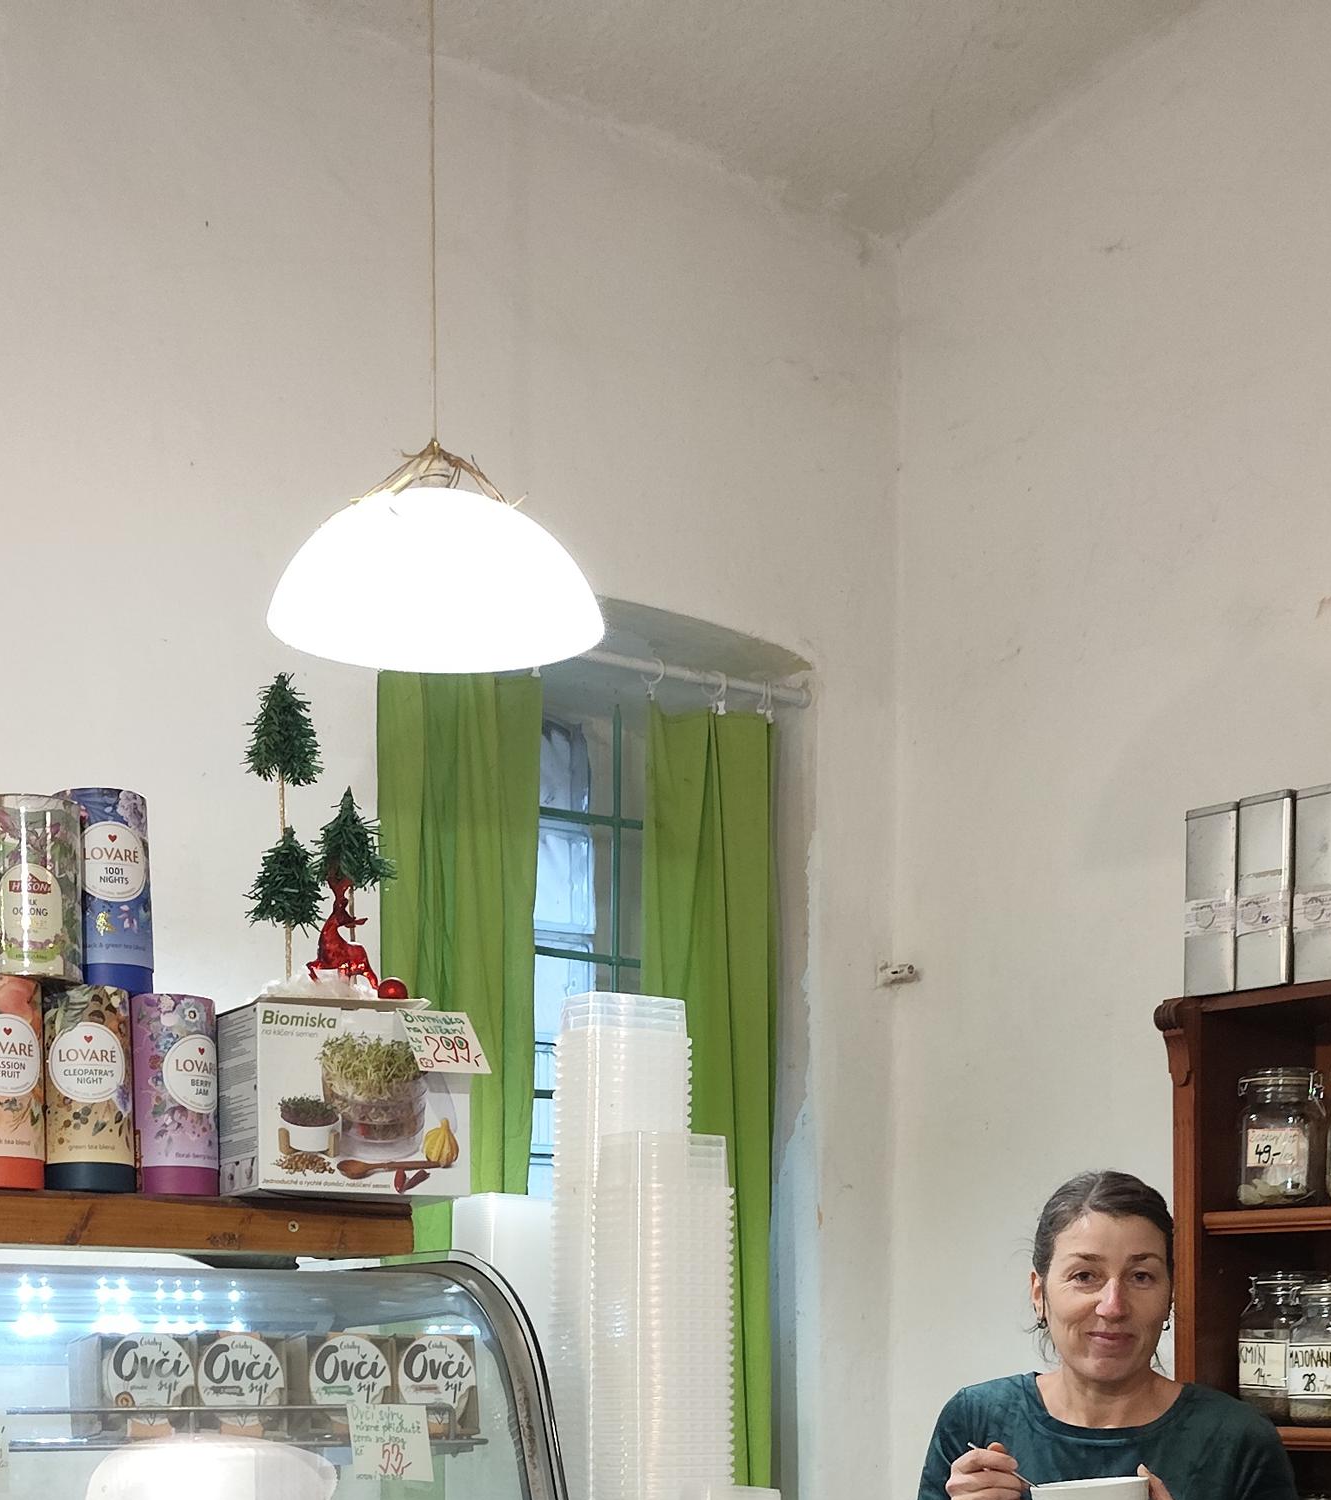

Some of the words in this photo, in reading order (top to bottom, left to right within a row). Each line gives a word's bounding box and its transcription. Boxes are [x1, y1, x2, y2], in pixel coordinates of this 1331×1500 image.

[82, 846, 139, 864] LOVARÉ
[104, 867, 124, 875] 1001
[99, 875, 129, 885] NIGHTS
[261, 1009, 337, 1030] Biomiska
[58, 1047, 117, 1064] LOVARÉ
[63, 1066, 115, 1078] CLEOPATRA'S
[76, 1076, 103, 1086] NIGHT
[190, 1078, 211, 1088] BERRY
[113, 1340, 191, 1382] Ovčí
[204, 1343, 279, 1383] Ovčí
[315, 1345, 388, 1384] Ovčí
[403, 1344, 475, 1384] Ovčí
